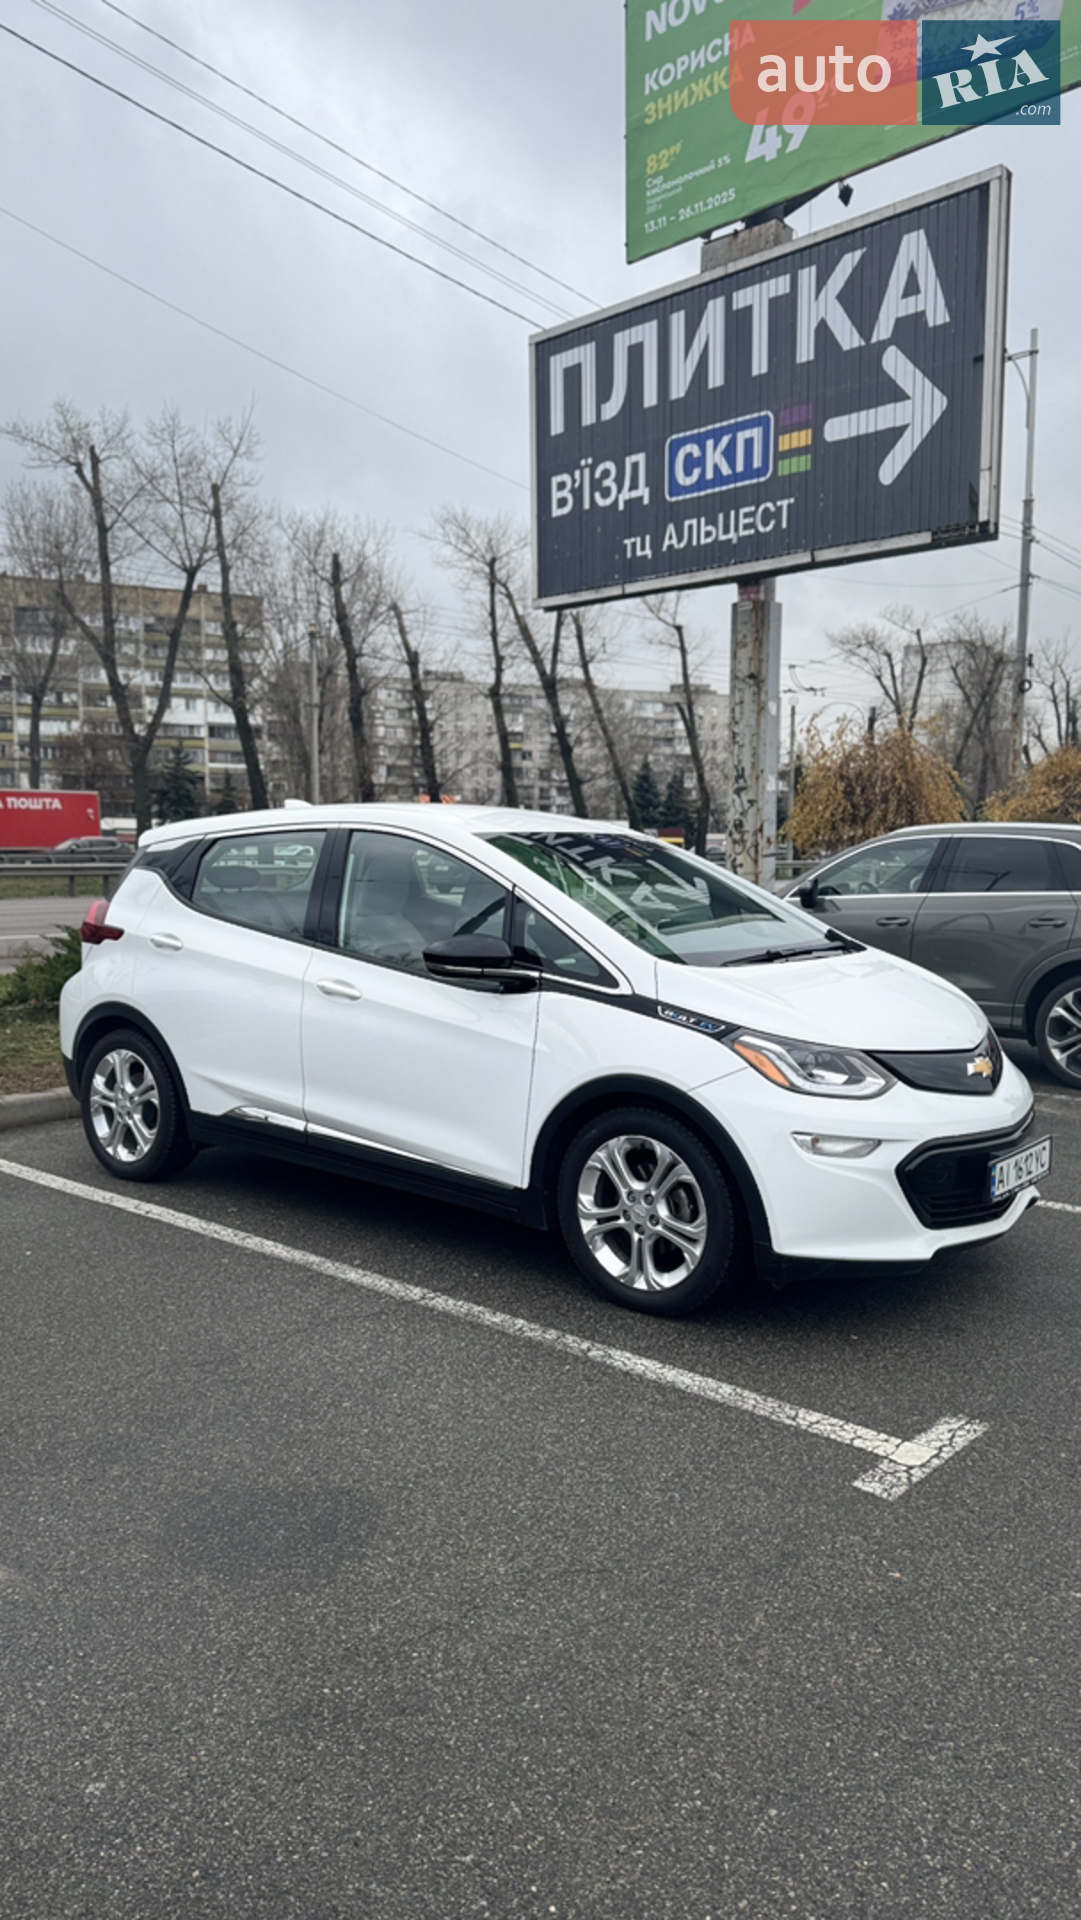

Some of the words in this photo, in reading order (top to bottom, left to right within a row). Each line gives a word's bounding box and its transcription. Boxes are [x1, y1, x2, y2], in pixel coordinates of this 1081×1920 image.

[644, 21, 757, 96] КОРИСНА
[643, 61, 744, 125] ЗНИЖКА
[550, 228, 951, 437] ПЛИТКА
[675, 426, 764, 487] СКП
[661, 497, 796, 552] АЛЬЦЕСТ
[5, 796, 63, 810] ПОШТА
